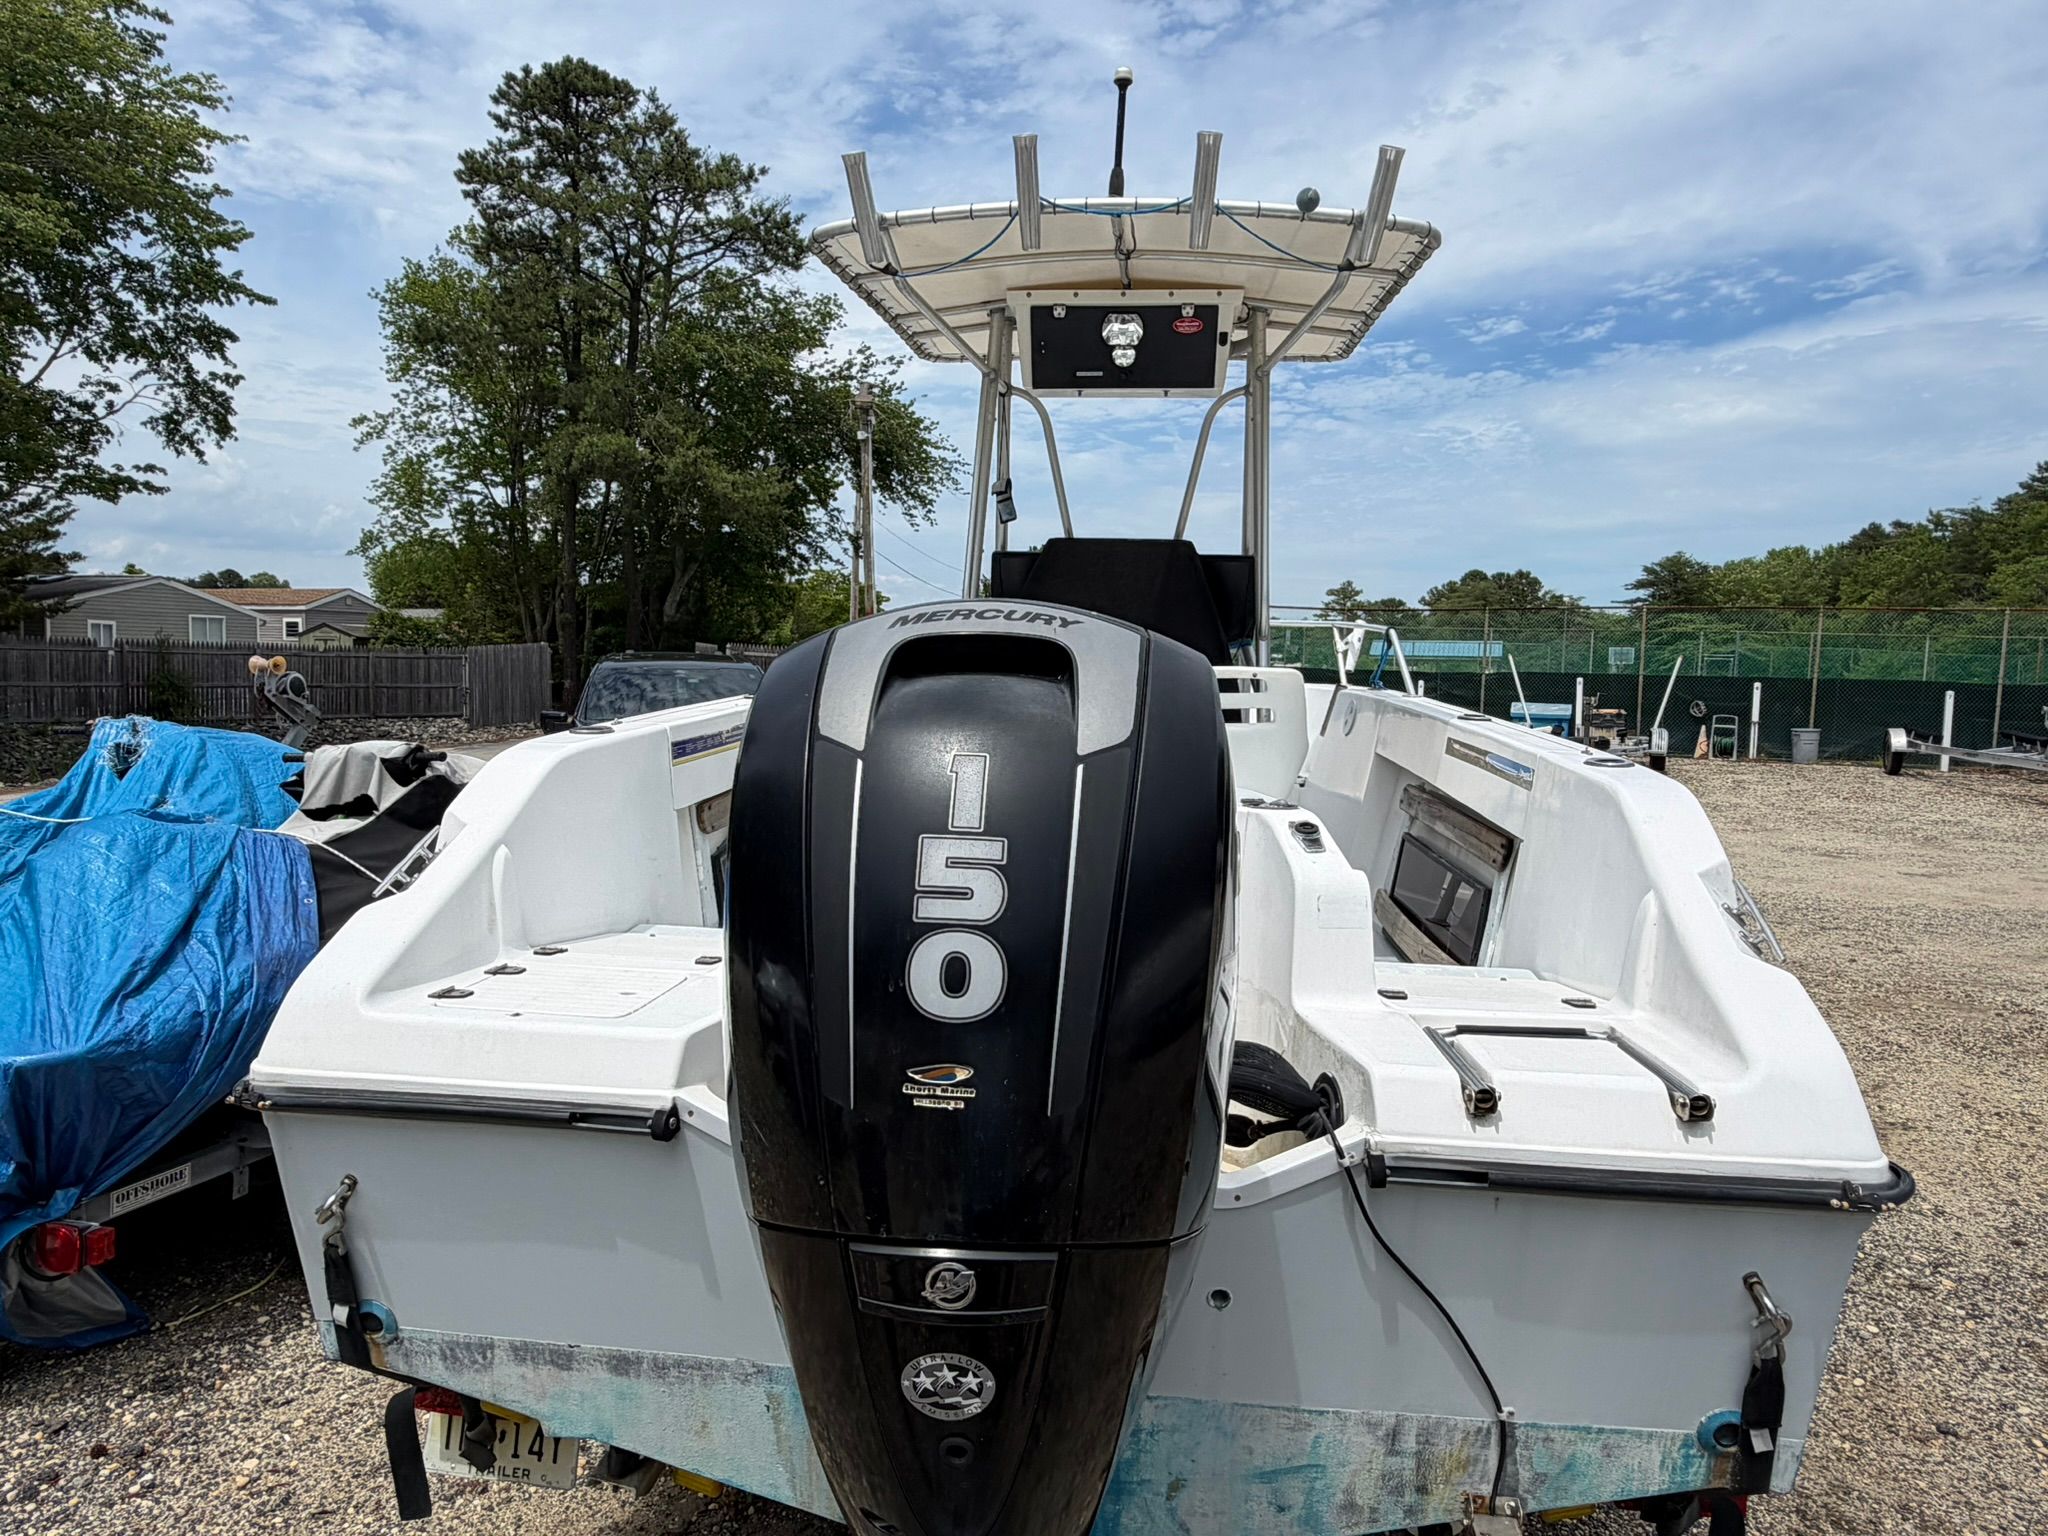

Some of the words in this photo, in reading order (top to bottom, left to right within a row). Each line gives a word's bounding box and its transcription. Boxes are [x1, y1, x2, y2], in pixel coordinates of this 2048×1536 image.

[887, 608, 1085, 630] MERCURY
[905, 752, 1009, 1024] 150
[940, 1087, 975, 1096] Marine
[115, 1168, 188, 1204] OFFSHORE
[909, 1354, 947, 1371] ULTRA
[957, 1356, 985, 1372] LOW
[468, 1461, 531, 1480] TAILER
